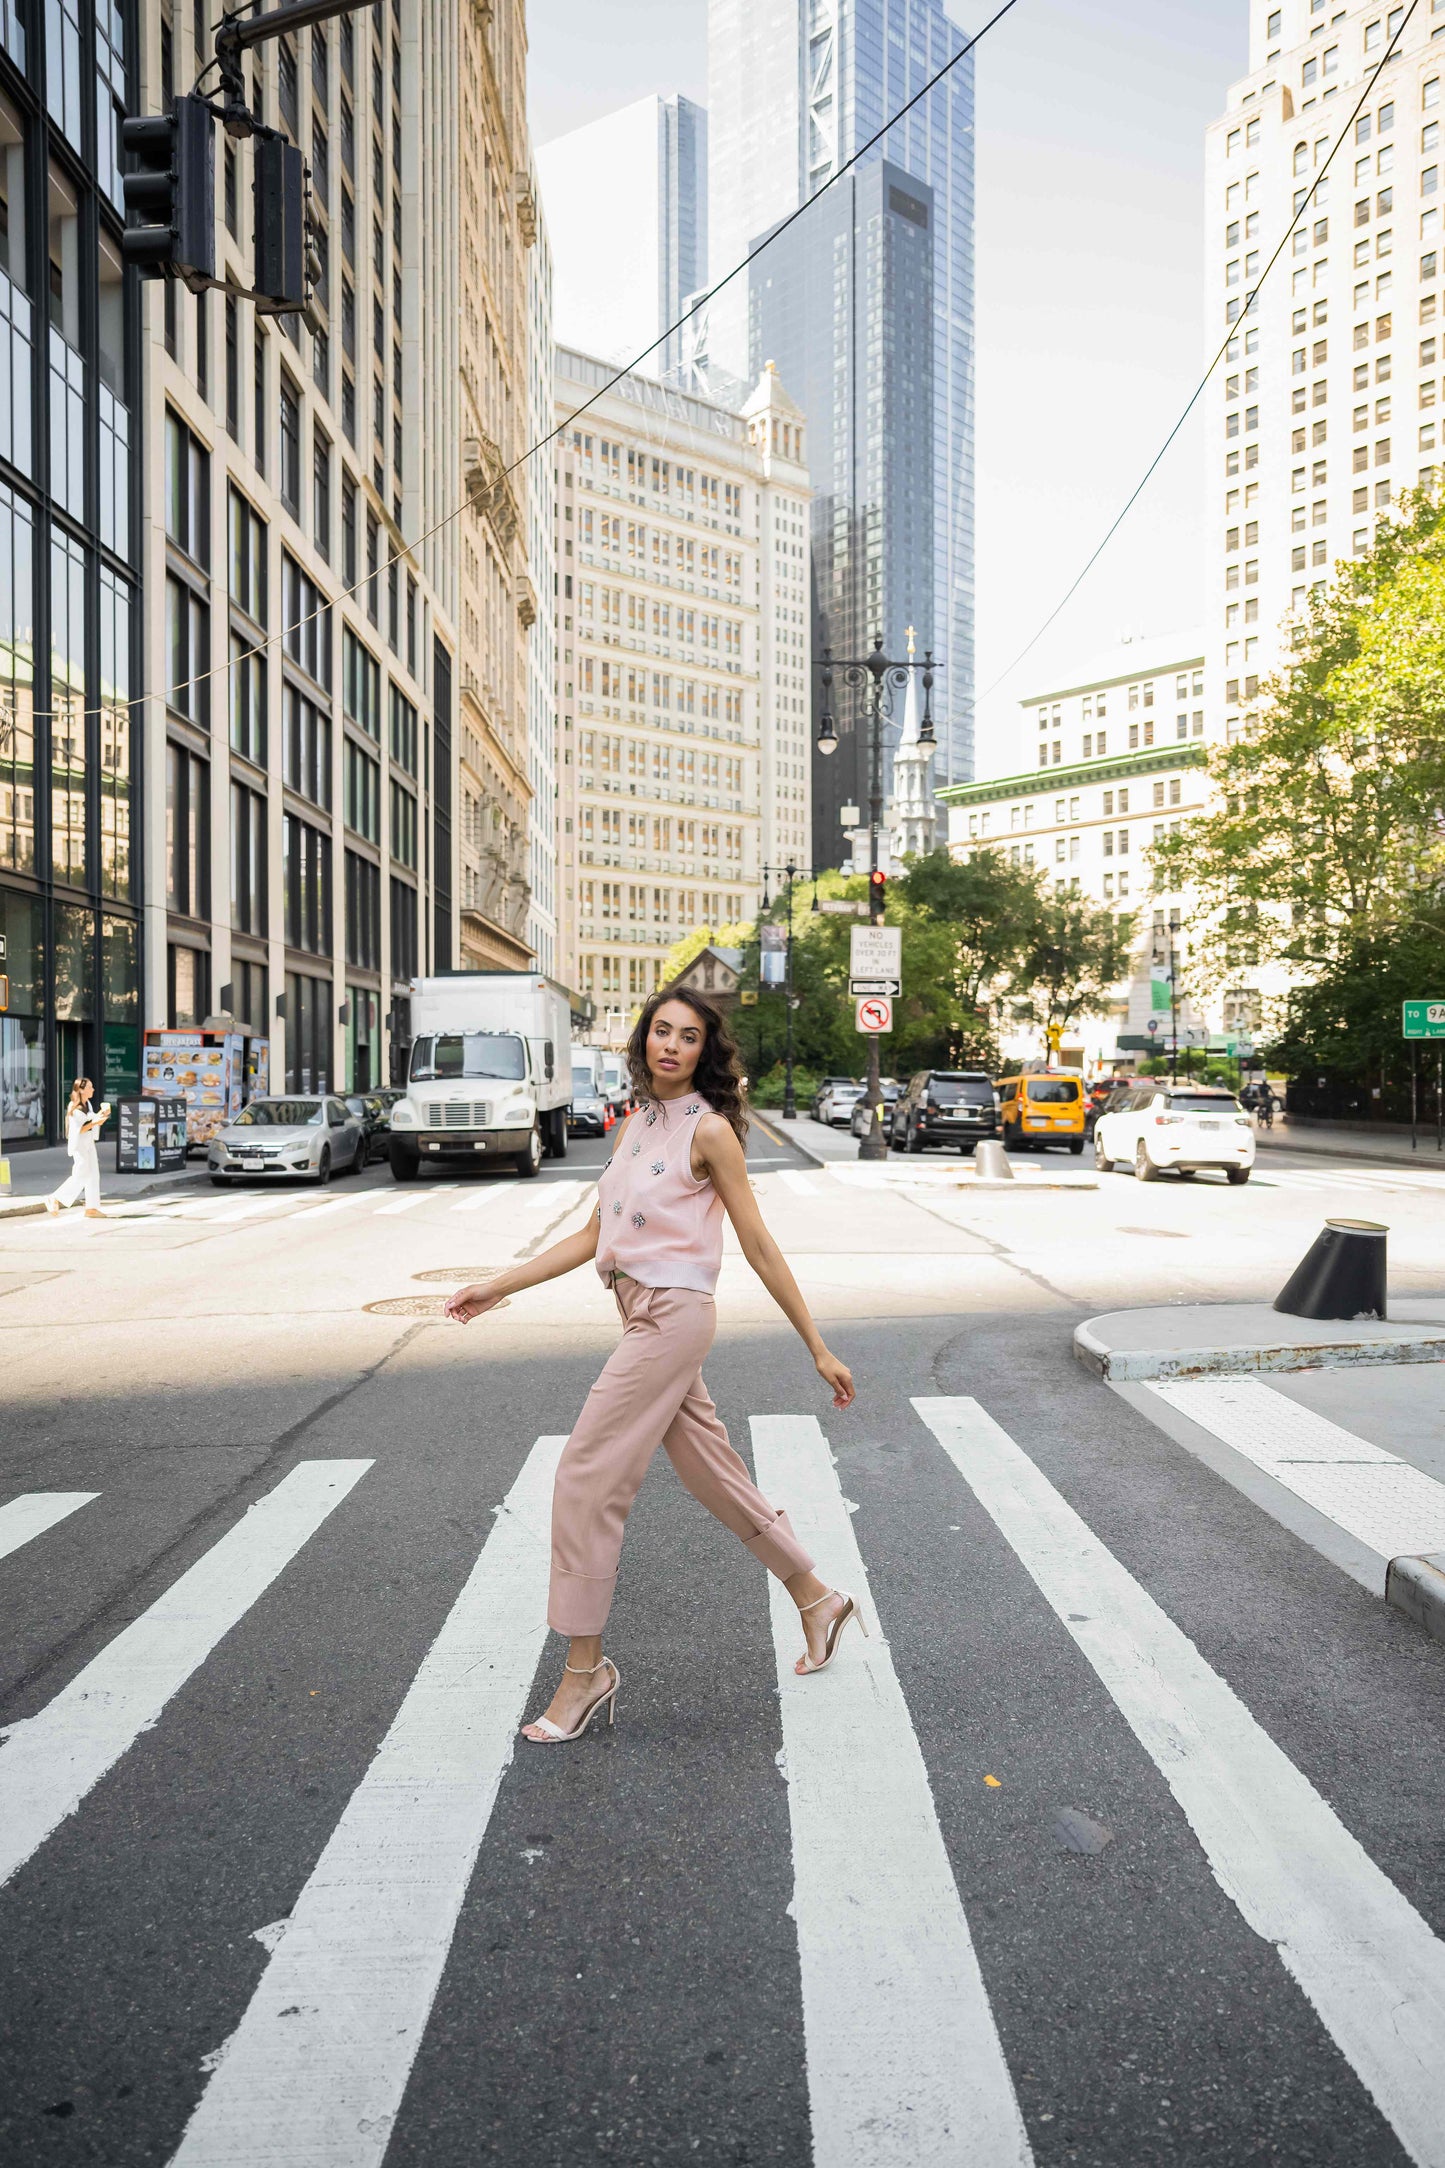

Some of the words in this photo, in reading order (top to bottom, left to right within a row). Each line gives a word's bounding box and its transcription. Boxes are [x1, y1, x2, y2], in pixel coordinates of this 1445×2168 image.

[869, 931, 883, 940] NO
[859, 941, 893, 949] VEHICLES
[855, 949, 874, 957] OVER
[855, 966, 873, 974] LEFT
[875, 967, 895, 975] LANE
[1407, 1010, 1420, 1018] TO
